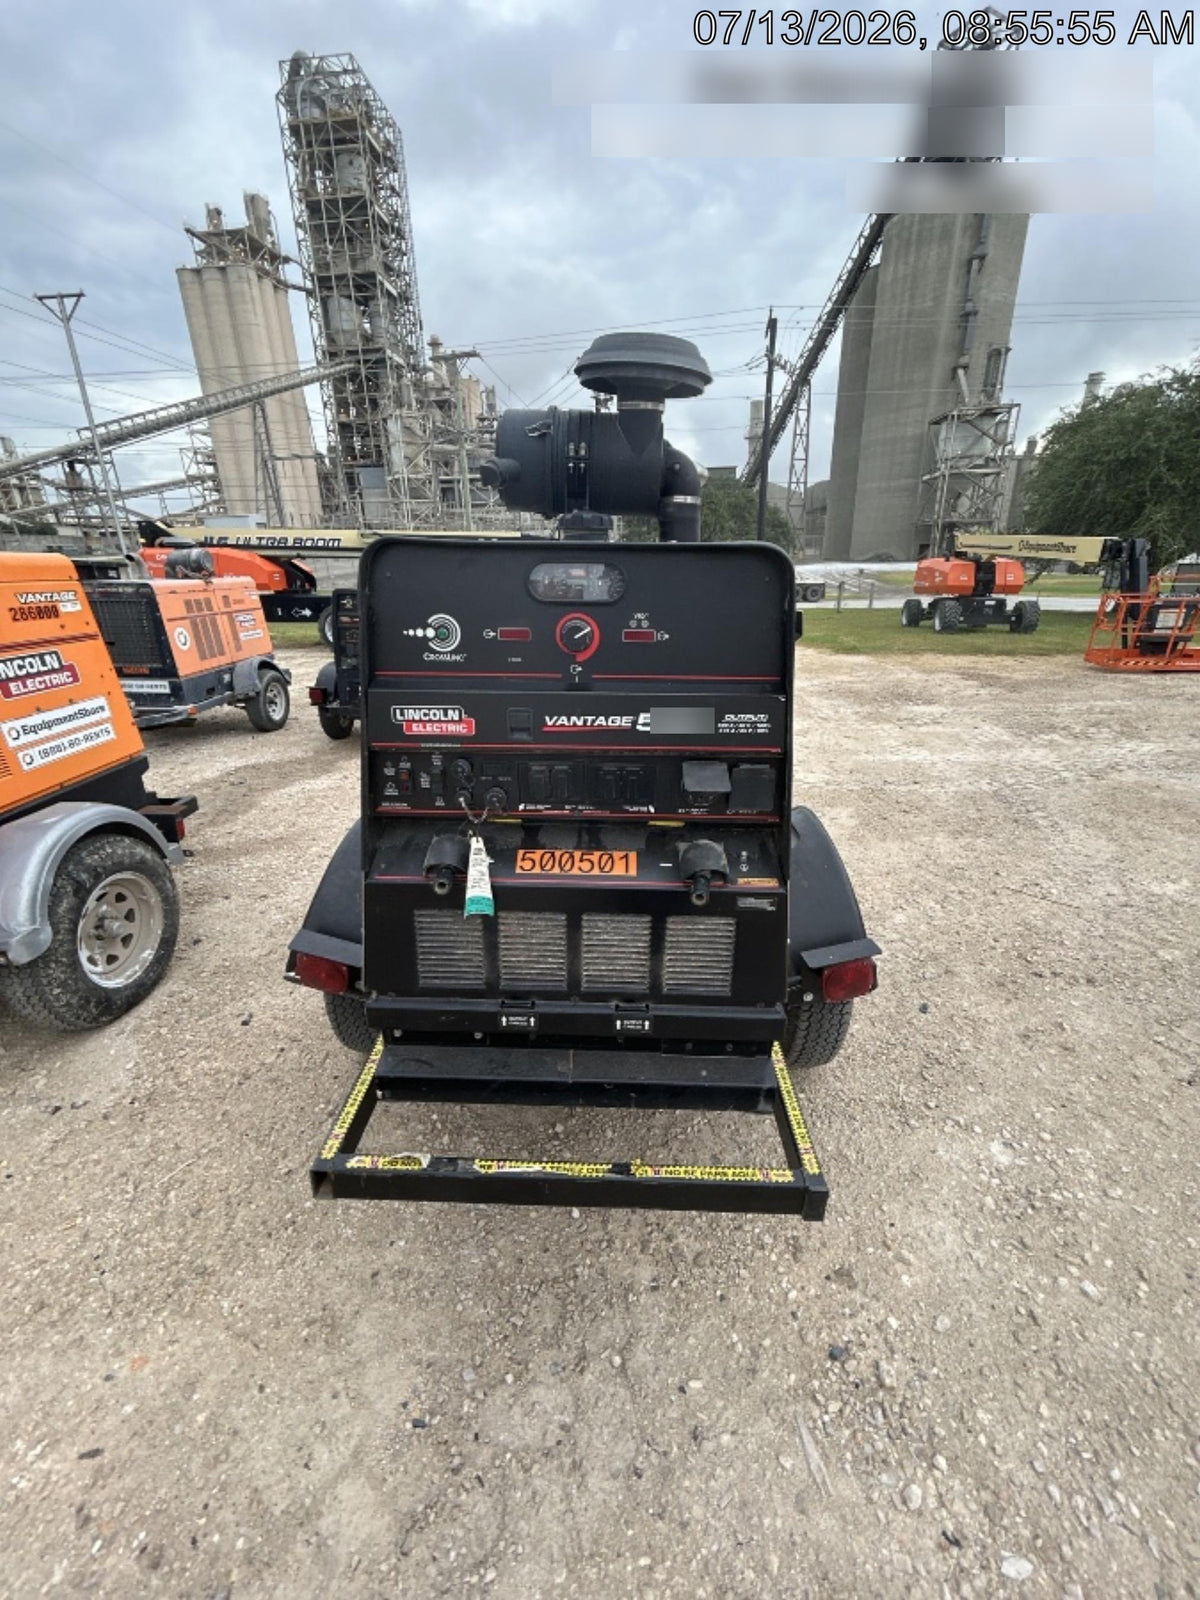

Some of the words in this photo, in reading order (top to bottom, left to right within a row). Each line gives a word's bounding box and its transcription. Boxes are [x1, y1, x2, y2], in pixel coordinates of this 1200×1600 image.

[16, 591, 77, 604] VANTAGE
[0, 653, 60, 680] NCOLN
[9, 671, 74, 695] ELECTRIC
[395, 708, 460, 721] LINCOLN
[544, 715, 634, 726] VANTAGE
[411, 722, 469, 733] ELECTRIC
[519, 850, 630, 874] 500501
